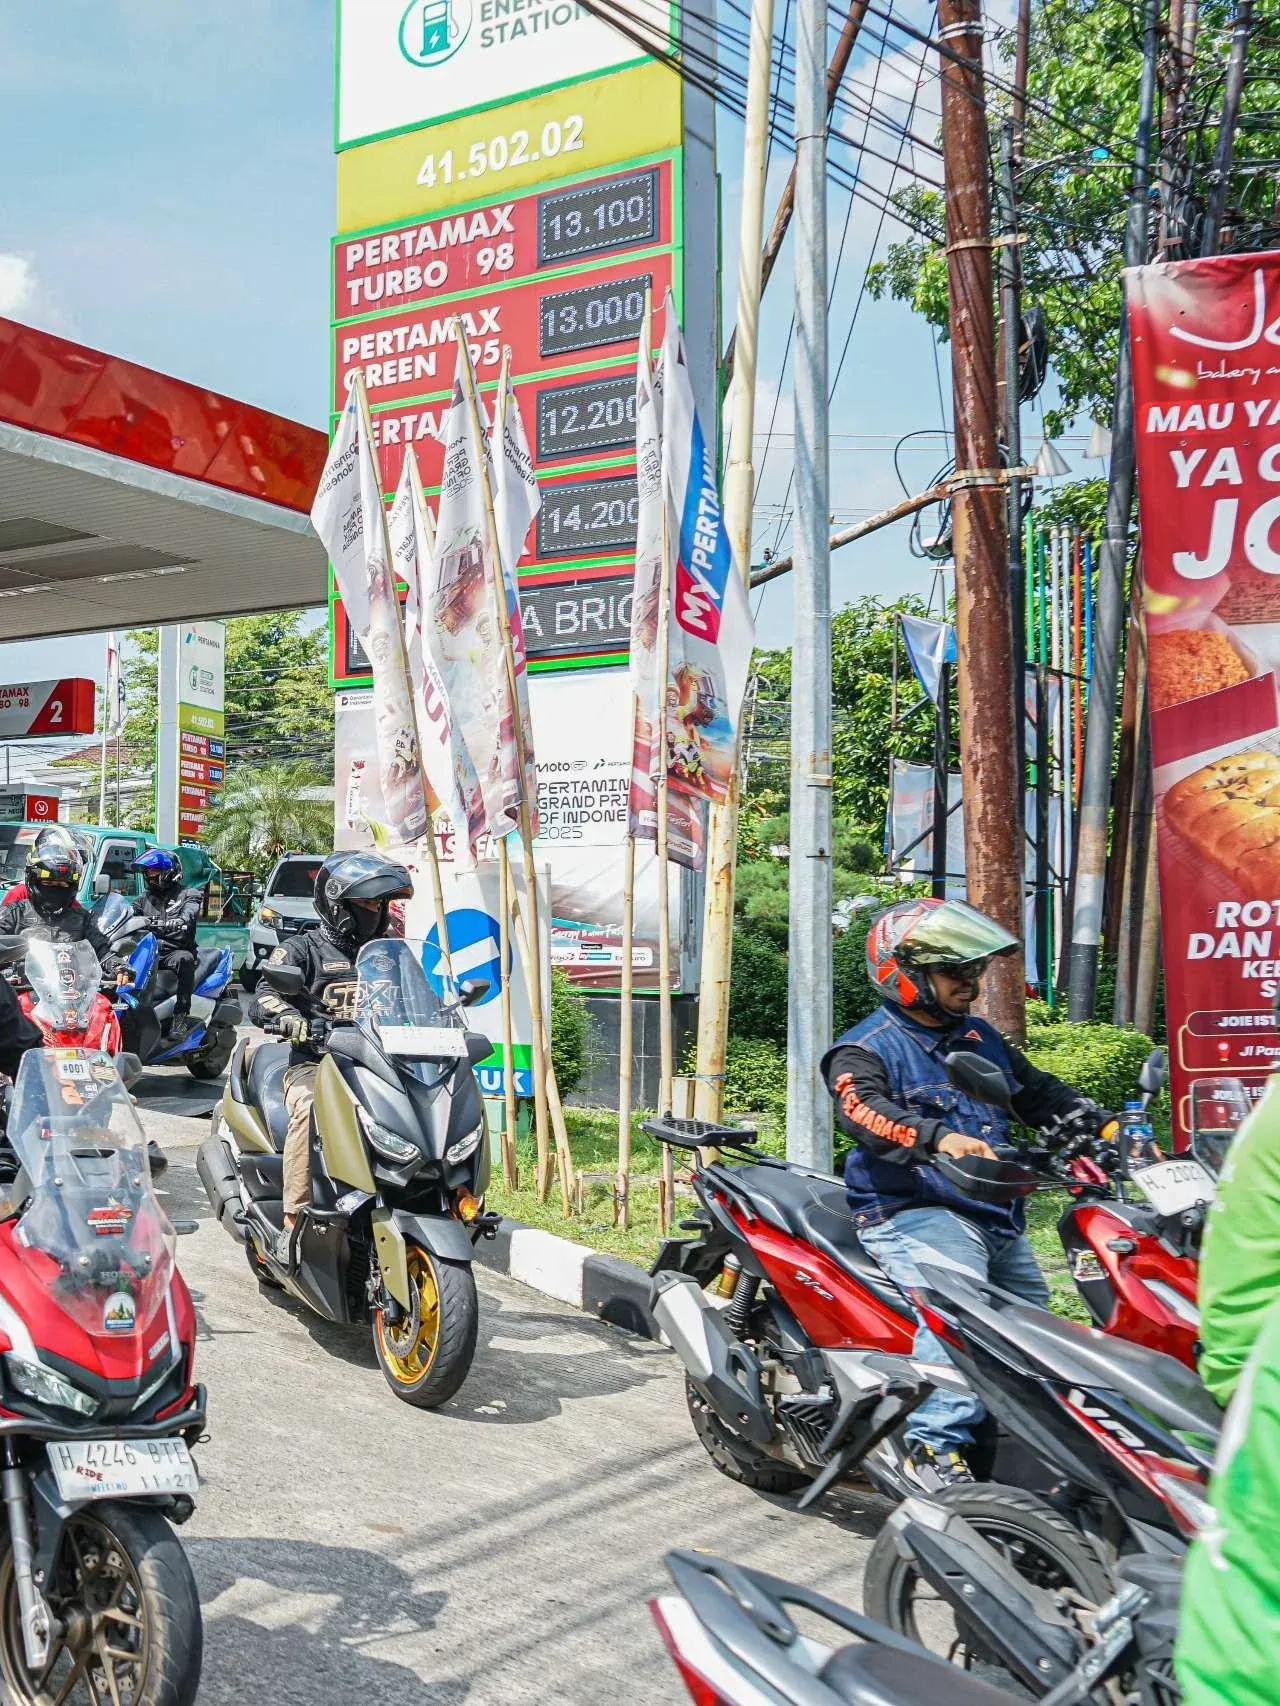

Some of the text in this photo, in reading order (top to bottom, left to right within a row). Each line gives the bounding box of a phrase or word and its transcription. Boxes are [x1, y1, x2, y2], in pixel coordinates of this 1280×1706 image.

[417, 115, 584, 188] 41.502.02
[549, 195, 645, 241] 13.100
[346, 205, 515, 271] PERTAMAX
[347, 243, 515, 306] TURBO 98
[543, 291, 644, 338] 13.000
[343, 305, 501, 364] PERTAMAX
[469, 339, 501, 367] 95
[1146, 401, 1235, 433] MAU
[1169, 447, 1244, 488] YA
[18, 698, 29, 708] 98
[49, 700, 63, 723] 2
[537, 779, 630, 795] PERTAMIN
[538, 794, 629, 810] GRAND PRI
[538, 809, 627, 825] OF INDONE
[538, 826, 583, 839] 2025
[1187, 931, 1273, 960] DAN
[1218, 1016, 1253, 1027] JOIE
[63, 1063, 85, 1074] #001
[58, 1441, 190, 1471] H 4246 BTE
[75, 1465, 104, 1482] RIDE
